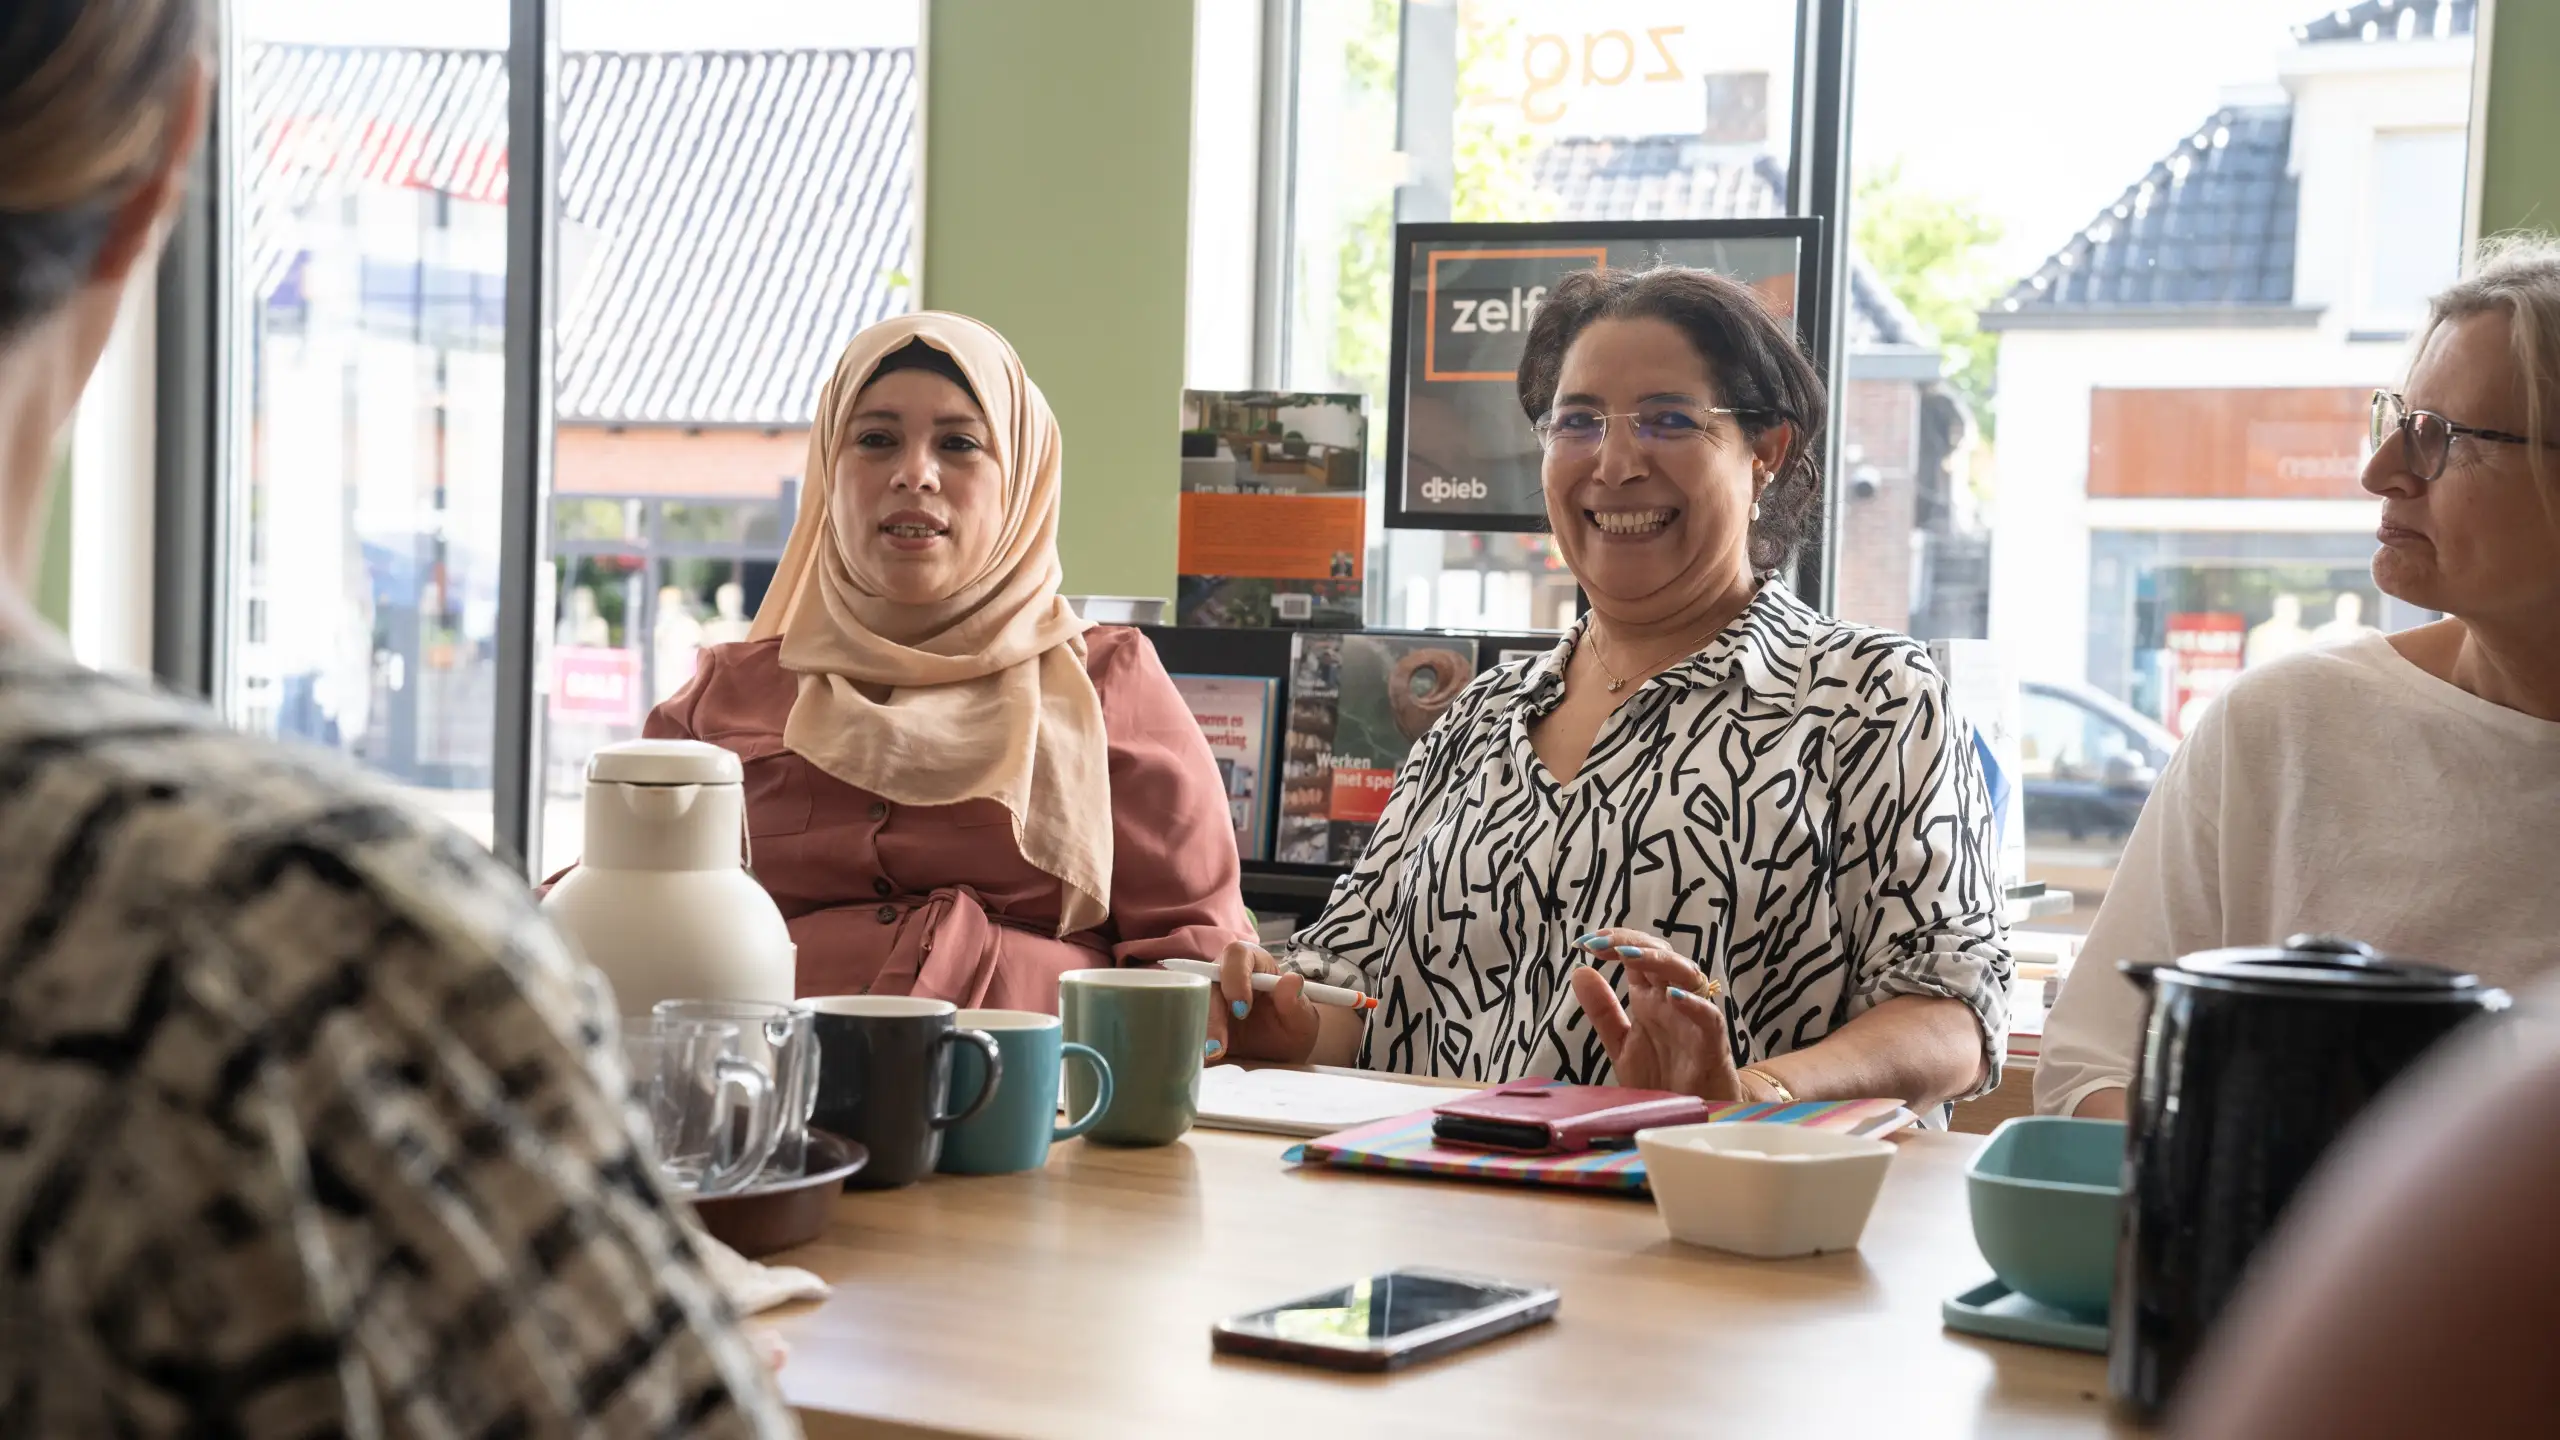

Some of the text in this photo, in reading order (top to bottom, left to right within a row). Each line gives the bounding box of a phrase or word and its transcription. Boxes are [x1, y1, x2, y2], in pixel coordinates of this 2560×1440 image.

[1451, 286, 1547, 333] zelf
[1421, 477, 1487, 503] dbieb
[1316, 752, 1371, 769] Werken
[1334, 773, 1362, 787] met
